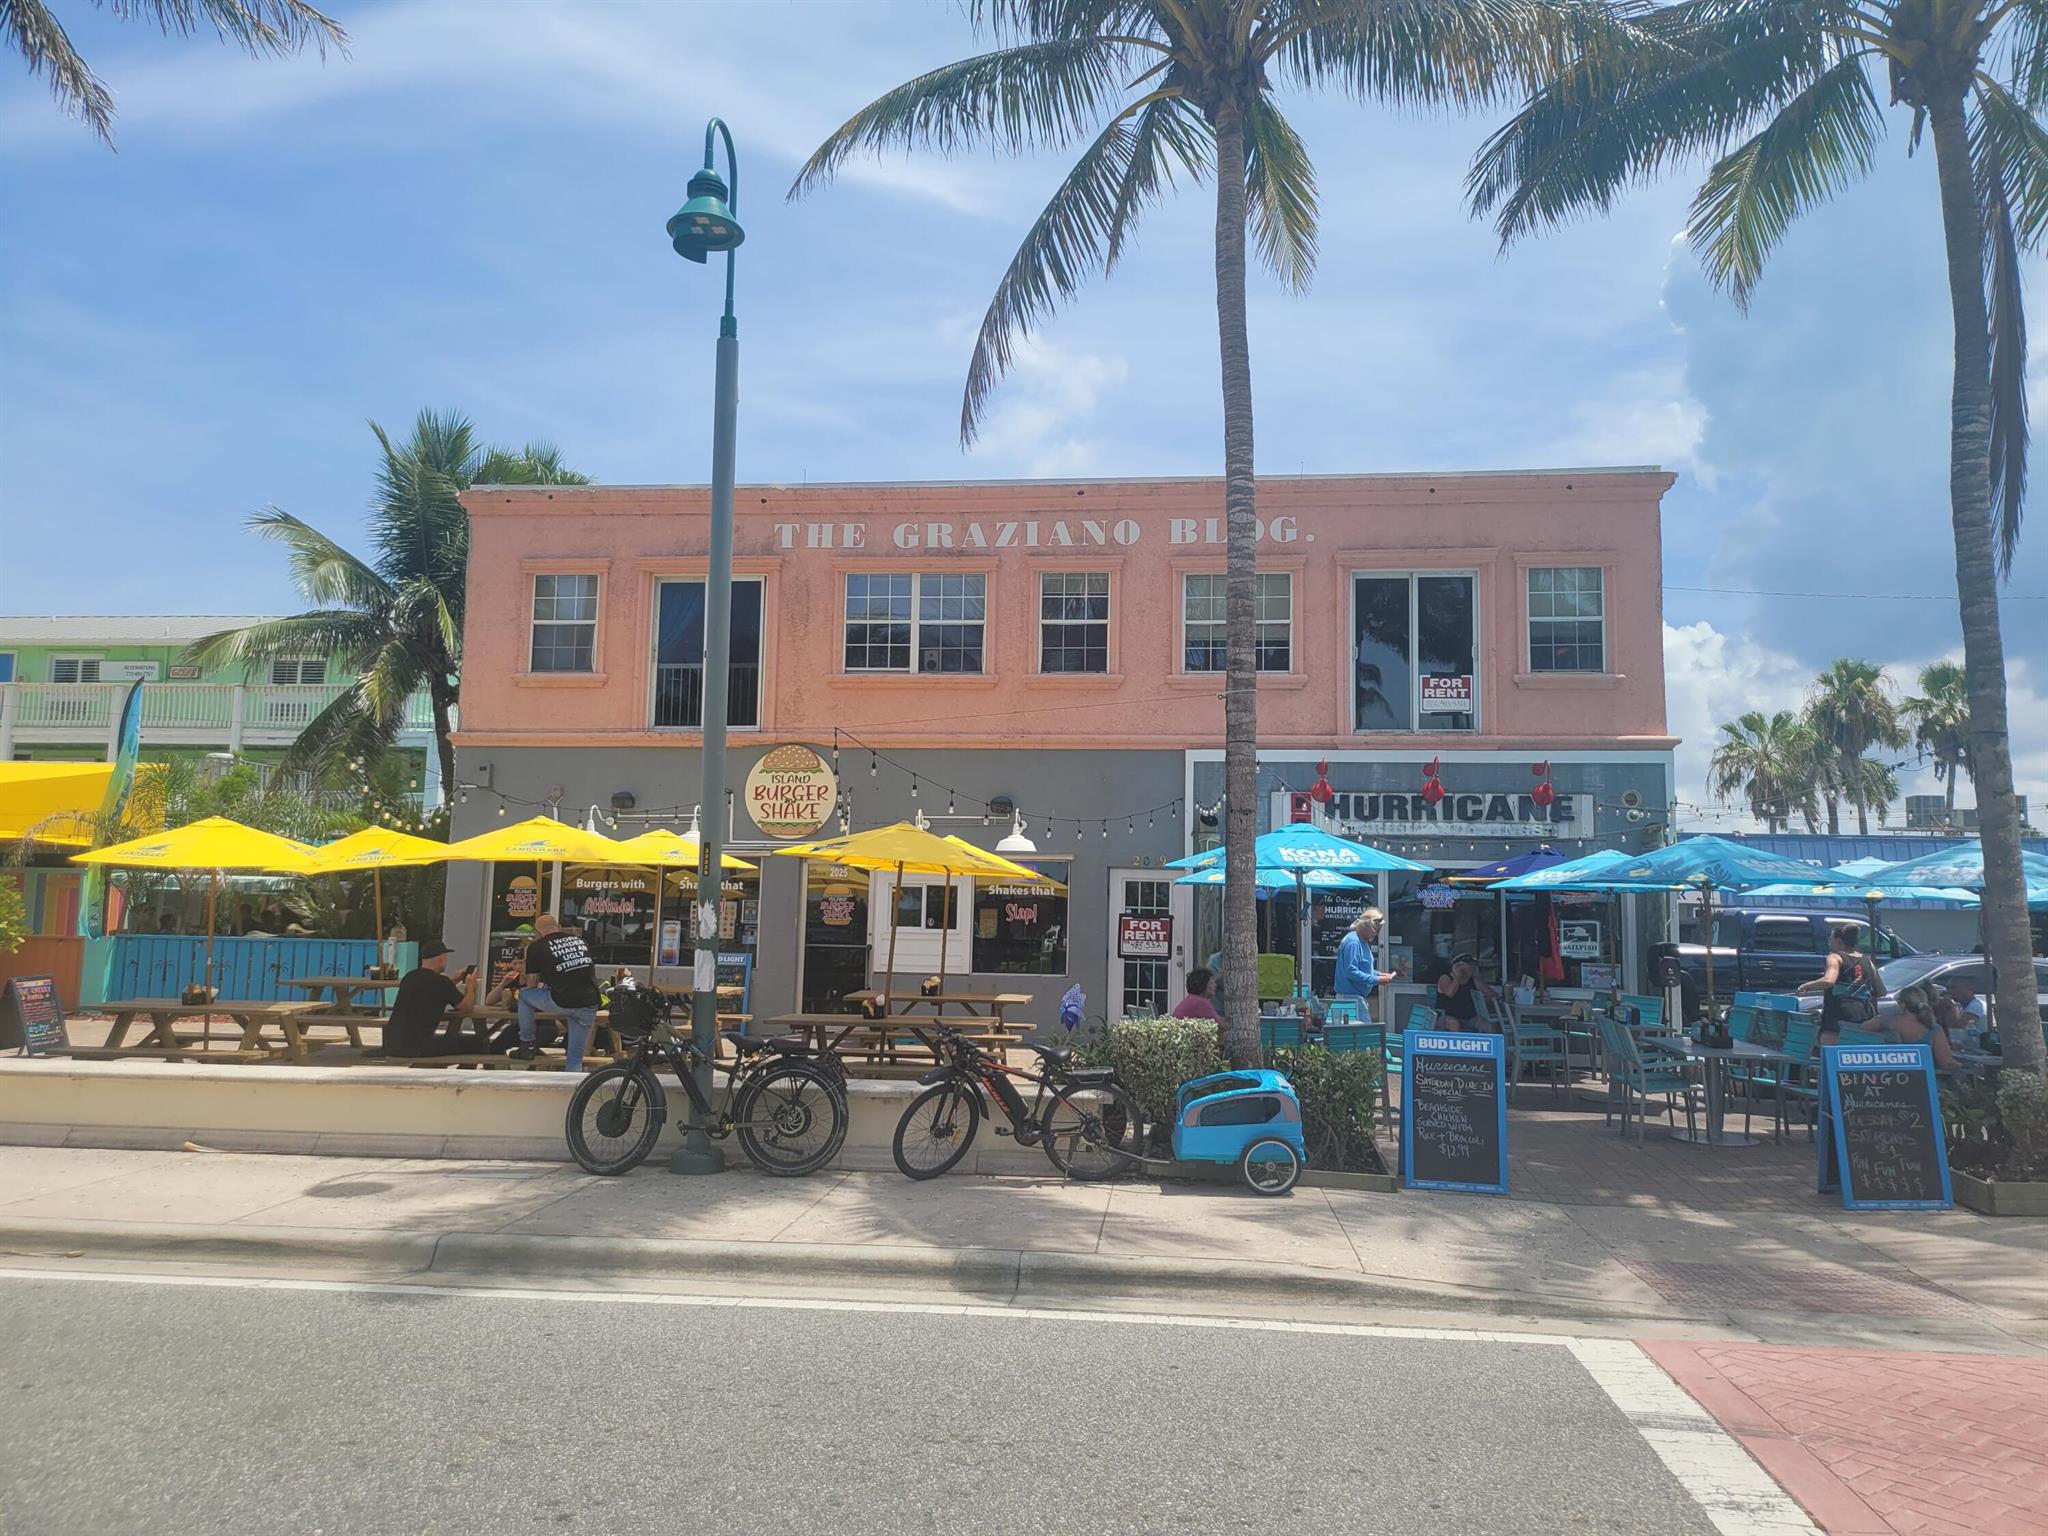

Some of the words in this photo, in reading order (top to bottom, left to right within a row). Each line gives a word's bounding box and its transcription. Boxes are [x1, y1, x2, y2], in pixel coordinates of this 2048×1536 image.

[774, 523, 866, 549] THE
[893, 519, 1141, 549] GRAZIANO
[1168, 516, 1315, 545] BLG.
[1429, 678, 1463, 688] FOR
[1424, 688, 1469, 698] RENT
[771, 774, 811, 784] ISLAND
[753, 784, 829, 801] BURGER
[760, 803, 821, 820] SHAKE
[1325, 794, 1575, 822] HURRICANE
[1278, 847, 1361, 859] KONA
[1314, 857, 1363, 865] WAVE
[830, 868, 848, 878] 2025
[576, 878, 619, 891] Burgers
[621, 879, 645, 889] with
[680, 880, 698, 889] Sha
[721, 880, 744, 890] that
[989, 885, 1029, 896] Shakes
[1031, 886, 1055, 896] that
[1416, 888, 1460, 899] MANGO
[820, 901, 855, 911] BURGER
[1323, 895, 1333, 903] The
[1335, 895, 1362, 905] Original
[1422, 896, 1456, 909] CART
[584, 896, 635, 917] Attitude!
[1005, 903, 1038, 925] Slap!
[1129, 920, 1162, 931] FOR
[554, 935, 580, 945] WORK
[1124, 930, 1167, 941] RENT
[550, 940, 585, 952] HARDER
[552, 946, 577, 958] THAN
[562, 951, 585, 961] UGLY
[1418, 1038, 1448, 1050] BUD
[1449, 1039, 1490, 1052] LIGHT
[1841, 1053, 1873, 1064] BUD
[1873, 1052, 1917, 1064] LIGHT
[1415, 1056, 1490, 1074] Hurricane
[1839, 1072, 1910, 1087] BINGO
[1864, 1085, 1885, 1097] AT
[1414, 1099, 1464, 1115] BEACHSIDE
[1431, 1111, 1468, 1123] CHICKEN
[1910, 1112, 1926, 1129] 2
[1447, 1122, 1473, 1133] WITH
[1438, 1141, 1470, 1160] $12.99
[1873, 1160, 1897, 1177] FUN
[1898, 1157, 1922, 1171] FUN
